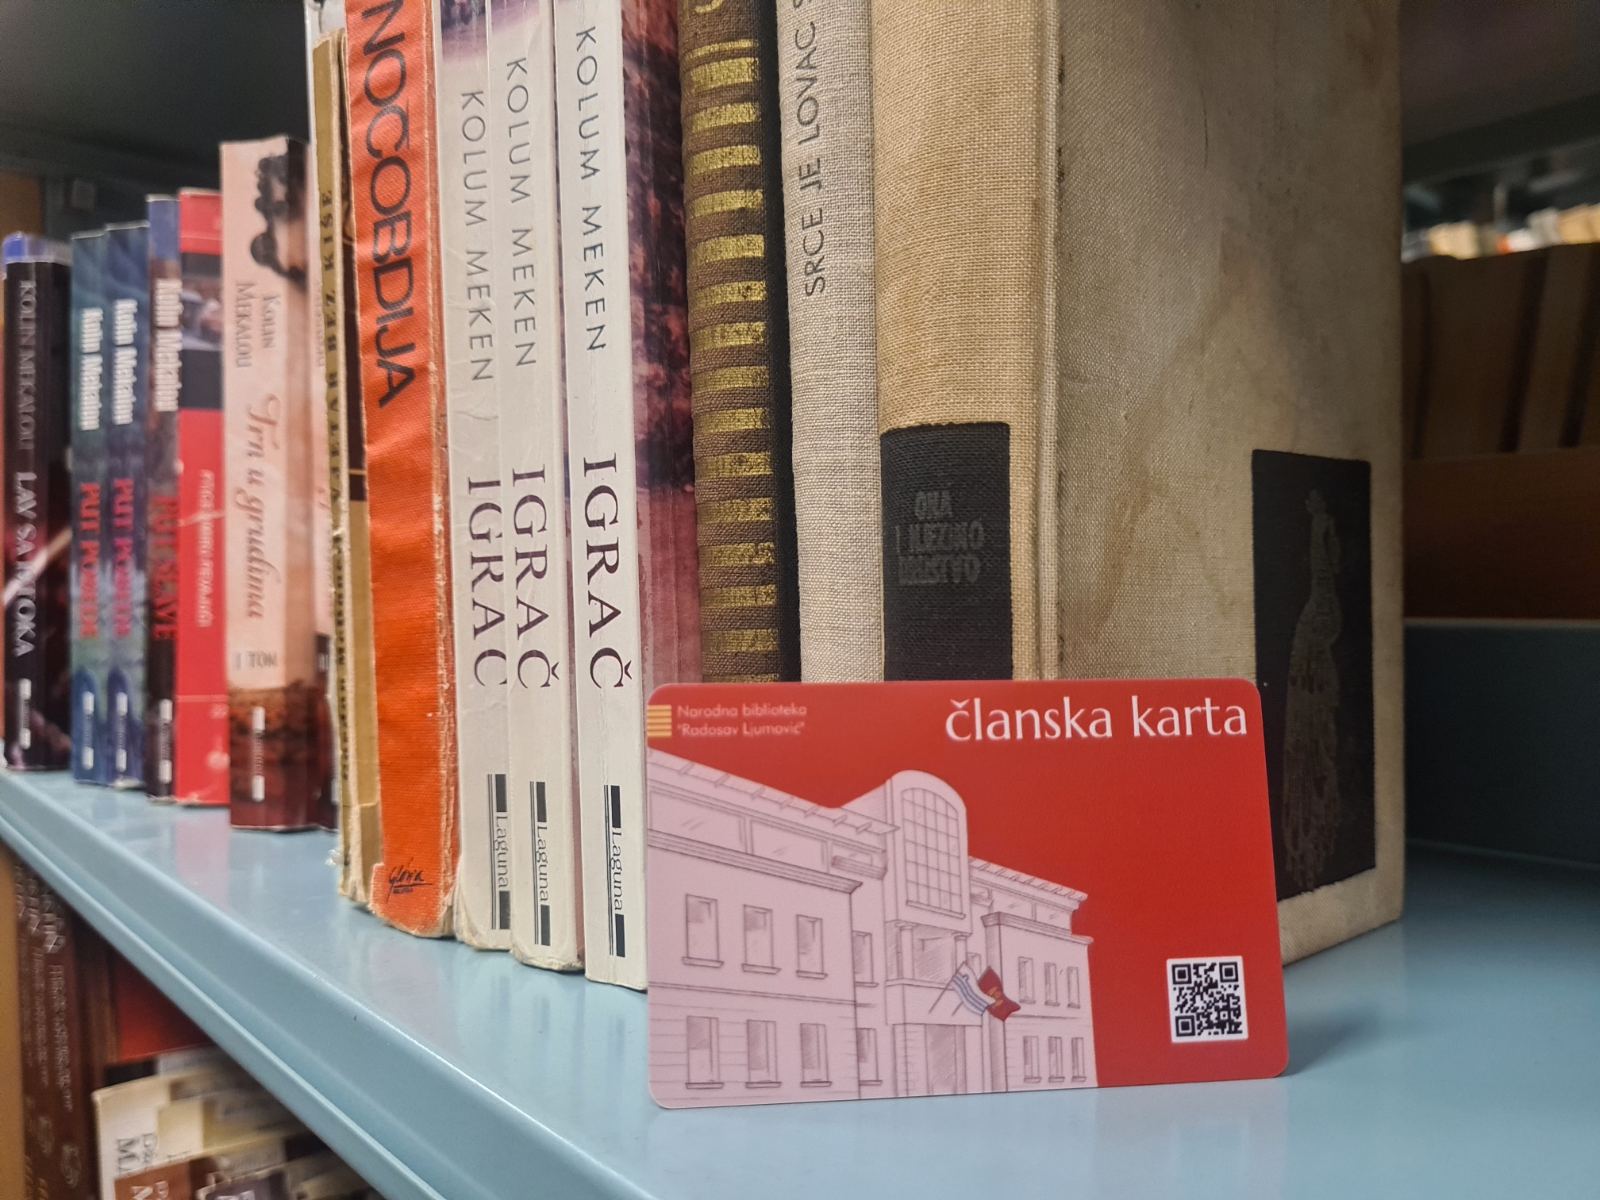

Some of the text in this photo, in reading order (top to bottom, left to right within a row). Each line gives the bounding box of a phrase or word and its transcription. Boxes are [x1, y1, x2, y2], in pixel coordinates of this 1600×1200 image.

[795, 21, 820, 146] LOVAC
[507, 57, 537, 367] KOLUM MEKEN
[576, 26, 607, 351] KOLUM MEKEN
[799, 158, 822, 193] JE
[461, 91, 493, 381] KOLUM MEKEN
[802, 208, 826, 297] SRCE
[15, 471, 38, 520] LAV
[235, 488, 281, 619] grudima
[512, 463, 560, 689] IGRAČ
[584, 452, 633, 689] IGRAČ
[677, 703, 808, 718] Narodna biblioteka
[945, 695, 1248, 741] članska karta
[495, 815, 510, 889] Laguna
[535, 822, 550, 905] Laguna
[609, 831, 625, 912] Laguna
